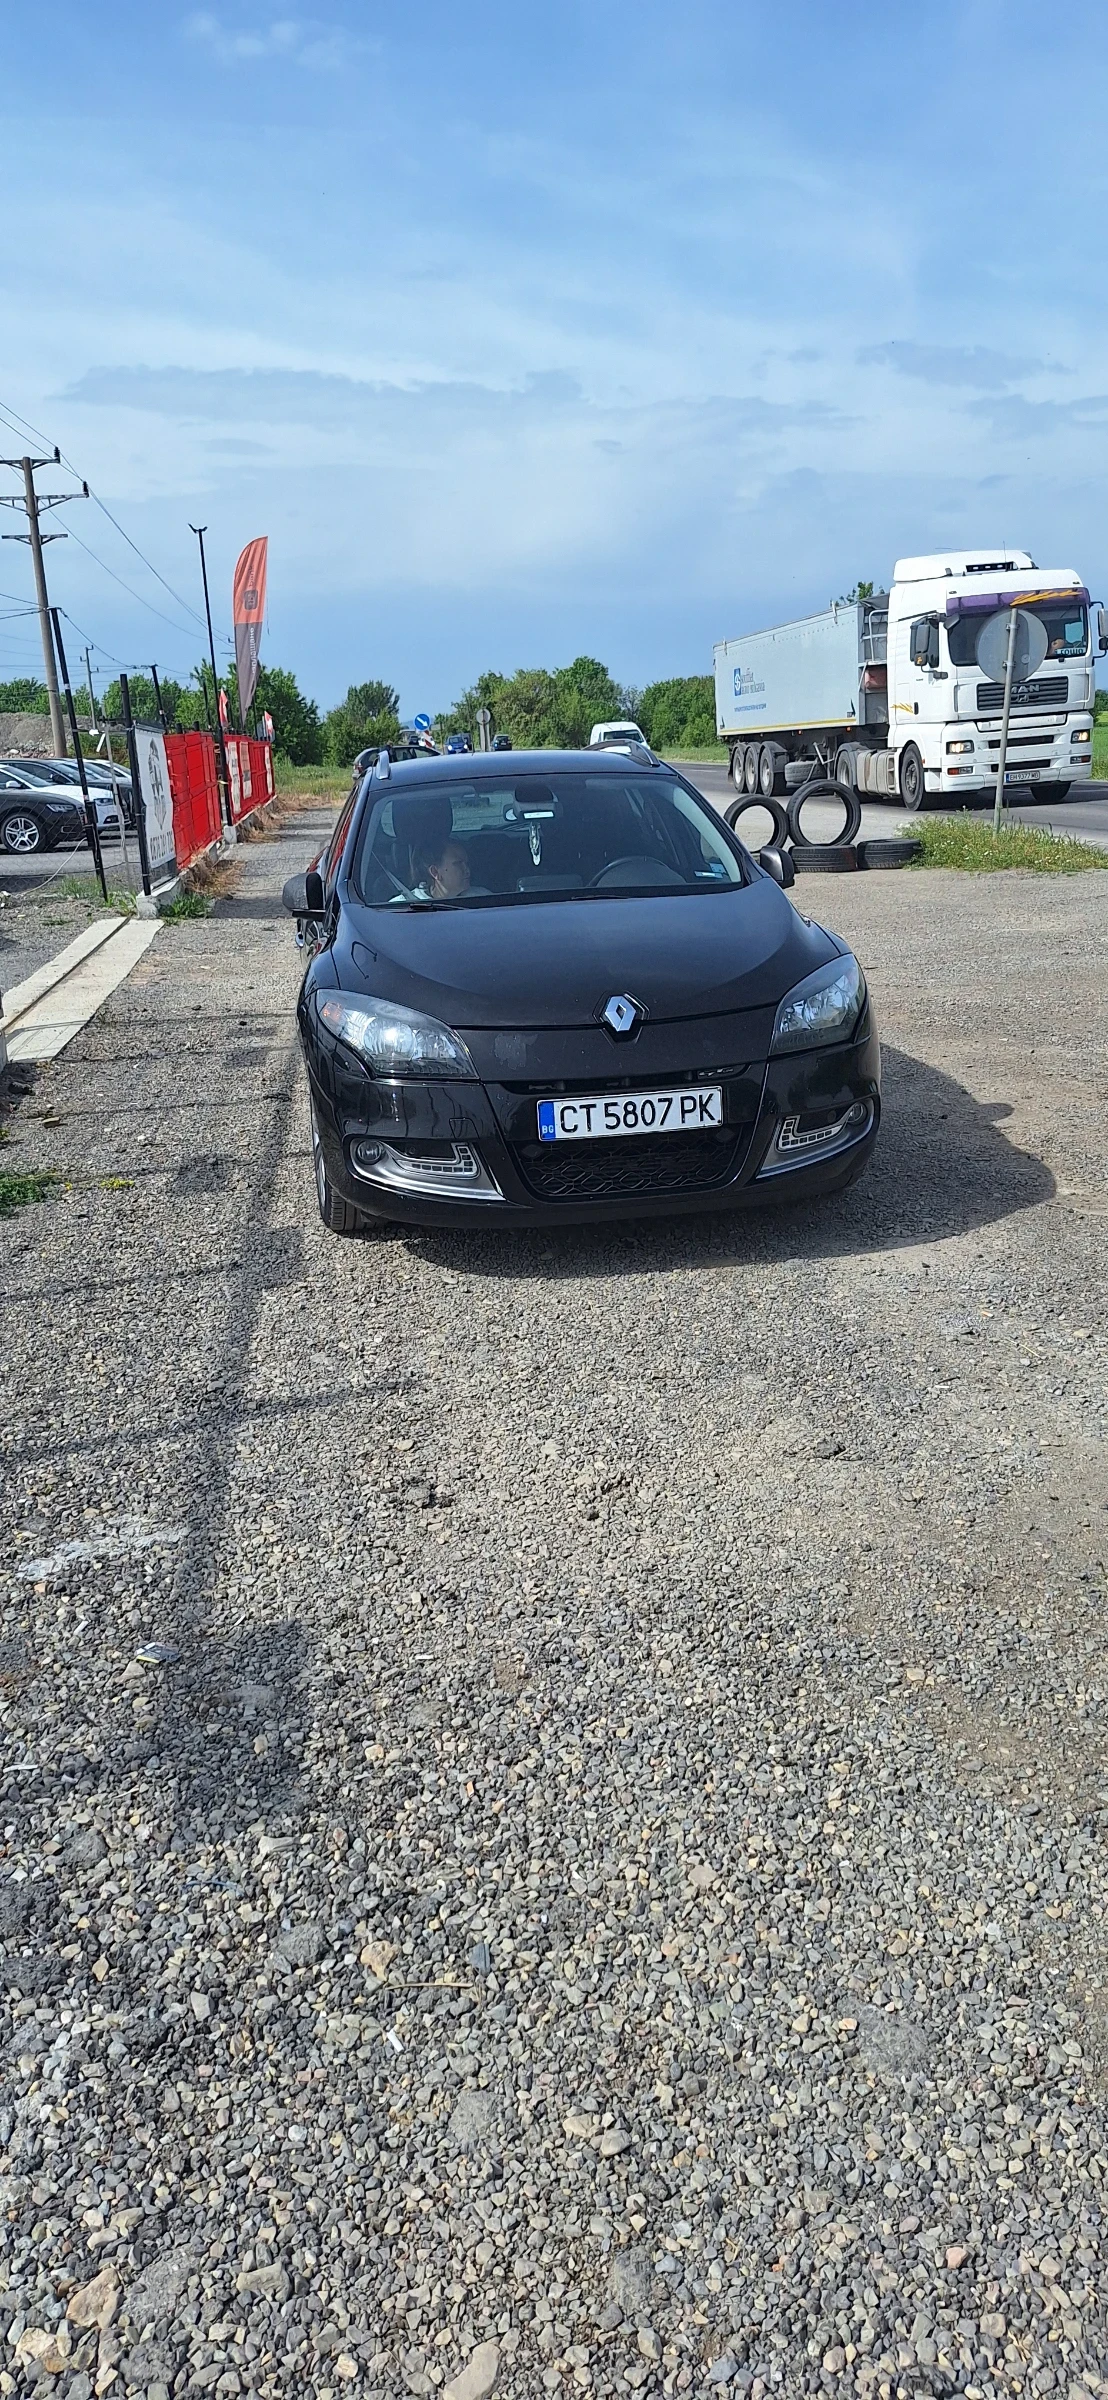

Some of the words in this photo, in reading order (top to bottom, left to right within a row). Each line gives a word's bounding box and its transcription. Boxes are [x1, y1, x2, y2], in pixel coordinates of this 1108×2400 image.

[559, 1103, 597, 1134] CT
[604, 1097, 673, 1130] 5807
[680, 1092, 716, 1124] PK
[542, 1124, 554, 1134] BG
